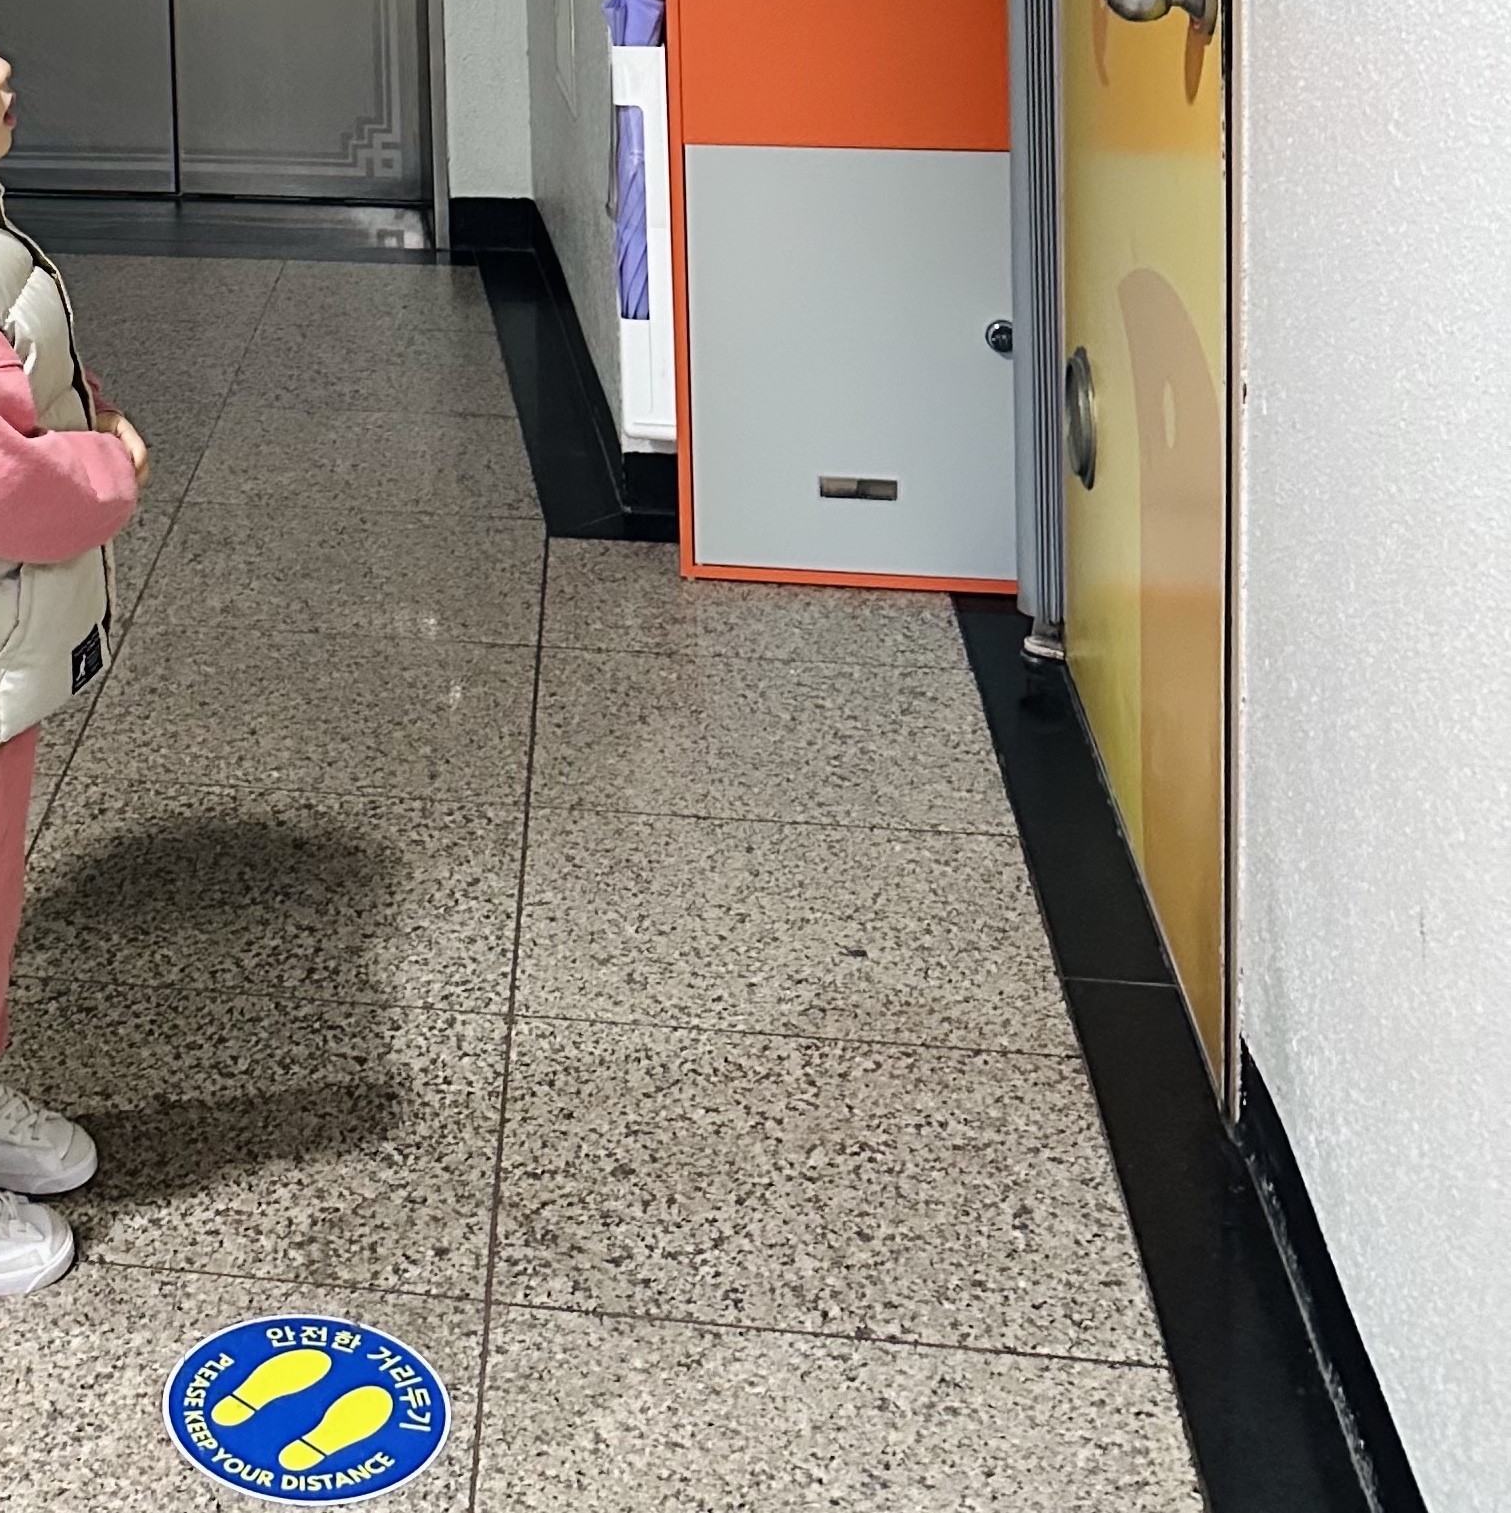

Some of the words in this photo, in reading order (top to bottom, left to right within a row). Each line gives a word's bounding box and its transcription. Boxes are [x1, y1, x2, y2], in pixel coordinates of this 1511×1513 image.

[182, 1352, 235, 1408] PLEASE
[266, 1325, 362, 1354] 안전한
[366, 1346, 432, 1432] 거리두기
[183, 1410, 218, 1451] KEEP
[210, 1446, 275, 1488] YOUR
[280, 1451, 397, 1492] DISTANCE
